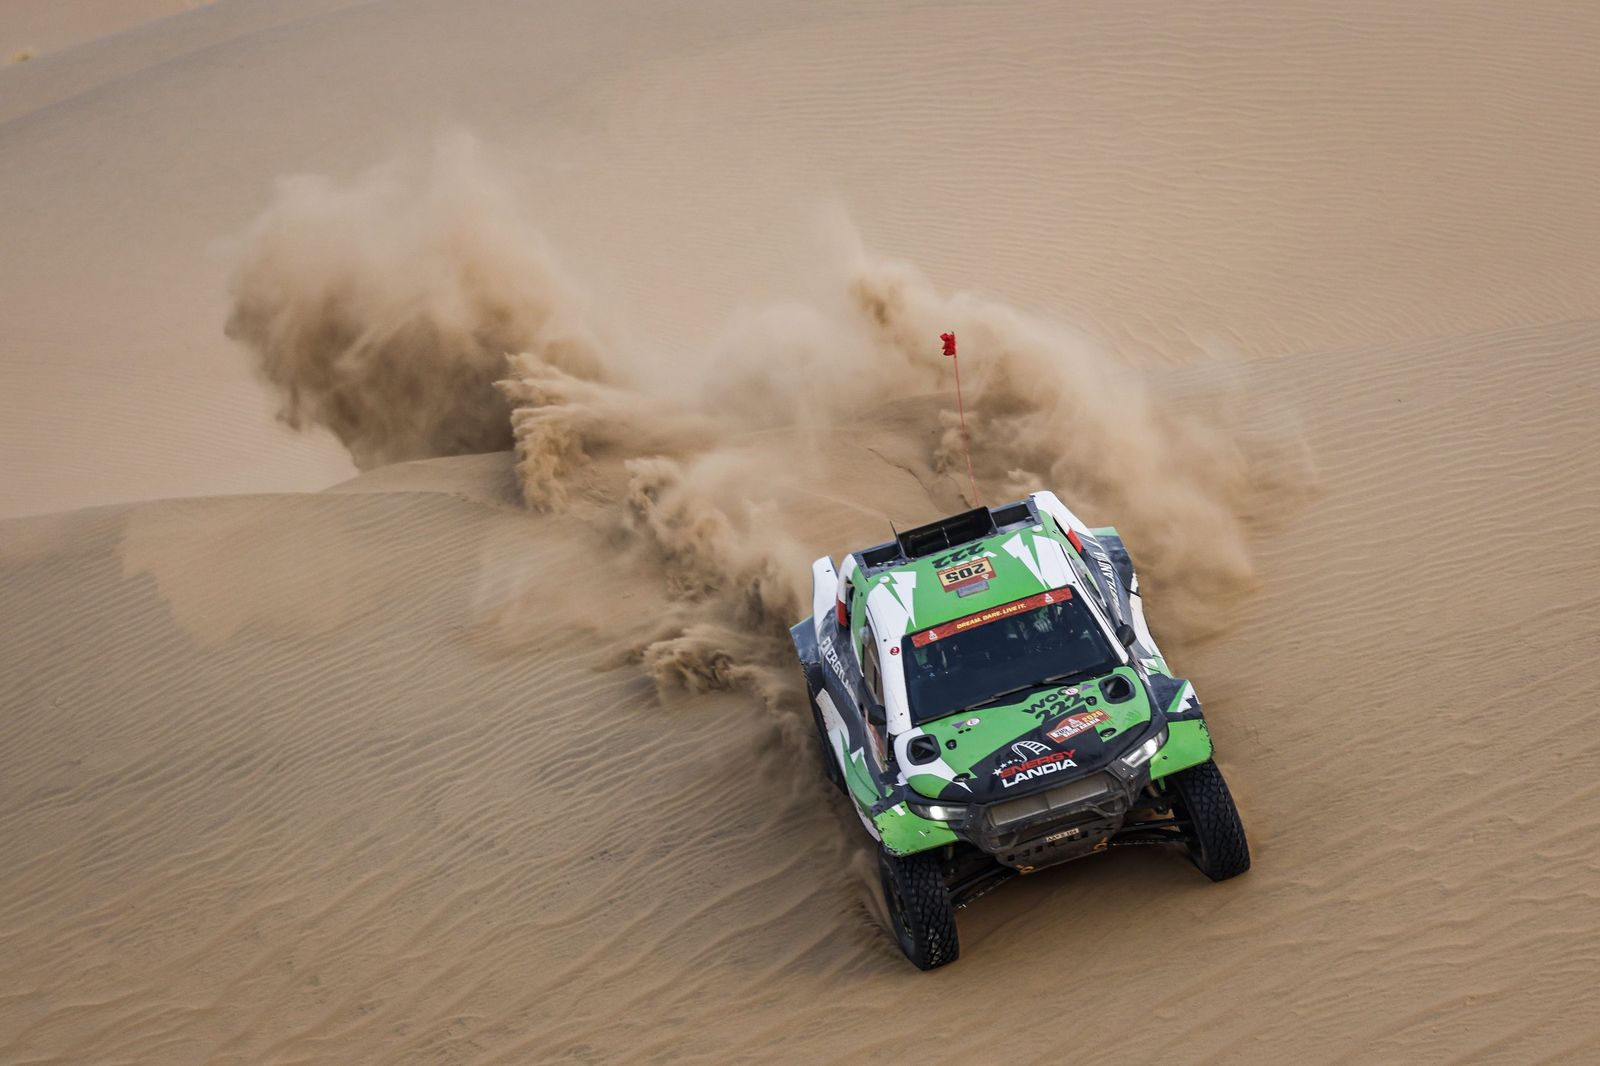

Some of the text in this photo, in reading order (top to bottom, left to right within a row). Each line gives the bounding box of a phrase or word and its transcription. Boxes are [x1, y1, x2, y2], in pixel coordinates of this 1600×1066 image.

[931, 542, 985, 569] 222
[945, 563, 986, 583] 205
[1035, 694, 1085, 726] 222
[1000, 749, 1077, 779] ENERGY
[1001, 759, 1078, 788] LANDIA
